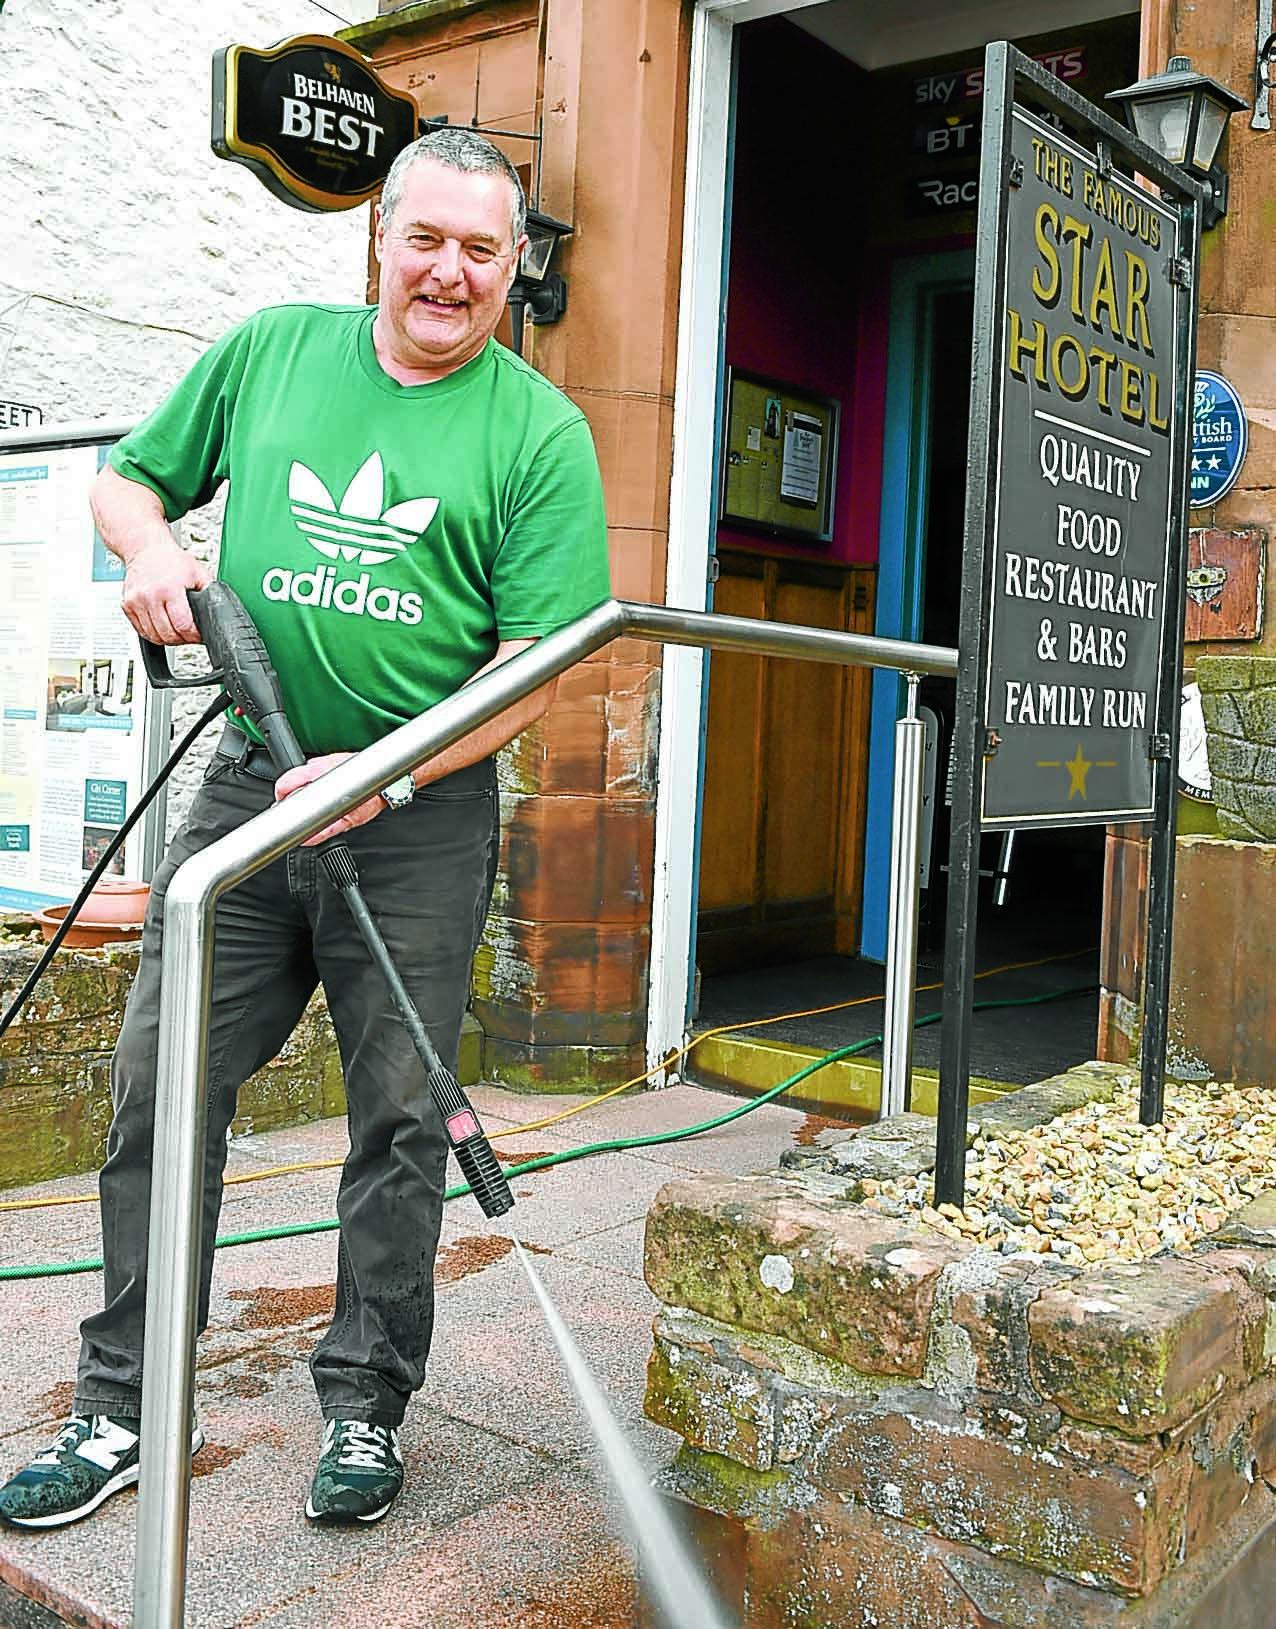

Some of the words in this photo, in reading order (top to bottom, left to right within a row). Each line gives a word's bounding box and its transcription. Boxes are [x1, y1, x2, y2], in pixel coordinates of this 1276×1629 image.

[294, 73, 375, 117] BELHAVEN
[916, 78, 956, 104] sky
[966, 52, 1082, 97] STS
[280, 96, 384, 157] BEST
[927, 124, 973, 153] BT
[918, 181, 977, 206] Rac
[1032, 137, 1073, 197] THE
[1084, 169, 1160, 250] FAMOUS
[1032, 203, 1154, 357] STAR
[1008, 308, 1170, 437] HOTEL
[0, 405, 32, 427] EET
[1193, 416, 1232, 436] ttish
[1202, 434, 1232, 443] BOARD
[1040, 433, 1141, 501] QUALITY
[1057, 504, 1121, 557] FOOD
[262, 563, 423, 625] adidas
[1005, 553, 1157, 619] RESTAURANT
[1037, 619, 1057, 661] &
[1069, 622, 1127, 669] BARS
[1005, 681, 1095, 727] FAMILY
[1102, 688, 1146, 729] RUN
[1184, 784, 1211, 800] MEM
